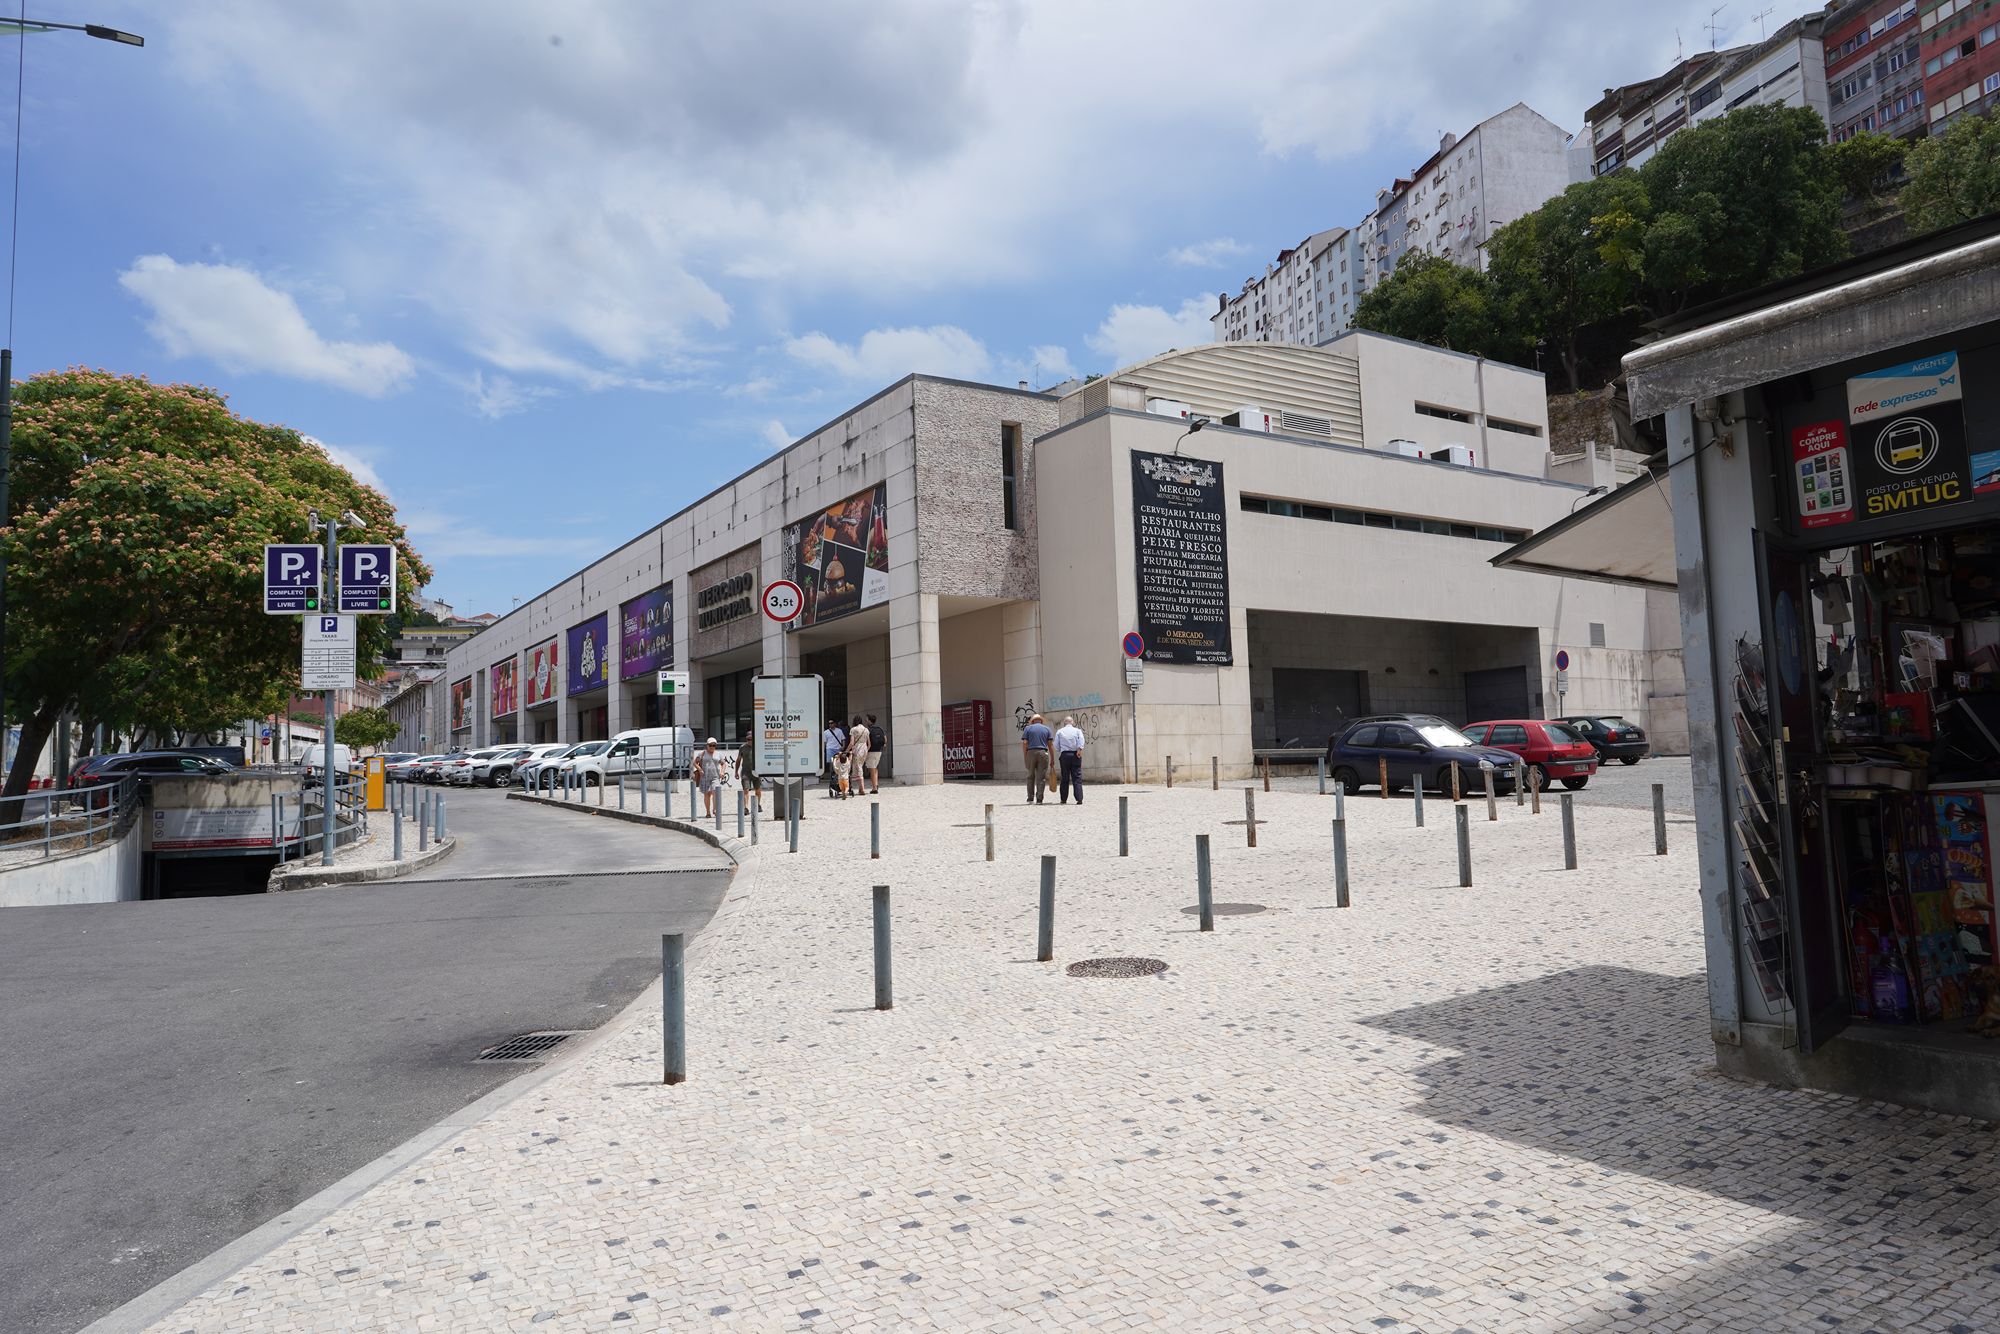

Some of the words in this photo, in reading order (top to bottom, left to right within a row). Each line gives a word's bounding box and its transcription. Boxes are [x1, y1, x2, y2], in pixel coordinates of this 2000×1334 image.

[1912, 356, 1948, 372] AGENTE
[1854, 400, 1878, 414] rede
[1880, 386, 1938, 408] expressos
[1799, 432, 1838, 447] COMPRE
[1808, 440, 1830, 452] AQUI
[1159, 484, 1200, 496] MERCADO
[1866, 483, 1900, 496] POSTO
[1903, 479, 1917, 488] DE
[1920, 471, 1958, 486] VENDA
[1867, 480, 1961, 514] SMTUC
[1140, 505, 1187, 518] CERVEJARIA
[1189, 510, 1220, 521] TALHO
[1141, 516, 1221, 532] RESTAURANTES
[1142, 526, 1181, 538] PADARIA
[1184, 533, 1221, 542] QUEIJARIA
[1142, 537, 1176, 549] PEIXE
[1180, 540, 1222, 553] FRESCO
[1142, 548, 1178, 557] GELATARIA
[1181, 552, 1222, 562] MERCEARIA
[1143, 556, 1187, 568] FRUTARIA
[281, 552, 305, 581] P
[355, 552, 378, 581] P
[294, 575, 301, 585] 1
[380, 574, 389, 584] 2
[1144, 575, 1188, 587] ESTÉTICA
[1173, 569, 1223, 579] CABELEIREIRO
[698, 572, 752, 608] MERCADO
[1144, 586, 1179, 594] DECORAÇÃO
[770, 596, 794, 608] 3,5t
[1144, 603, 1189, 613] VESTUÁRIO
[1178, 597, 1224, 606] PERFUMARIA
[698, 596, 752, 629] MUNICIPAL
[324, 619, 334, 631] P
[1173, 631, 1204, 639] MERCADO
[944, 743, 974, 760] baixa
[946, 761, 975, 771] COIMBRA
